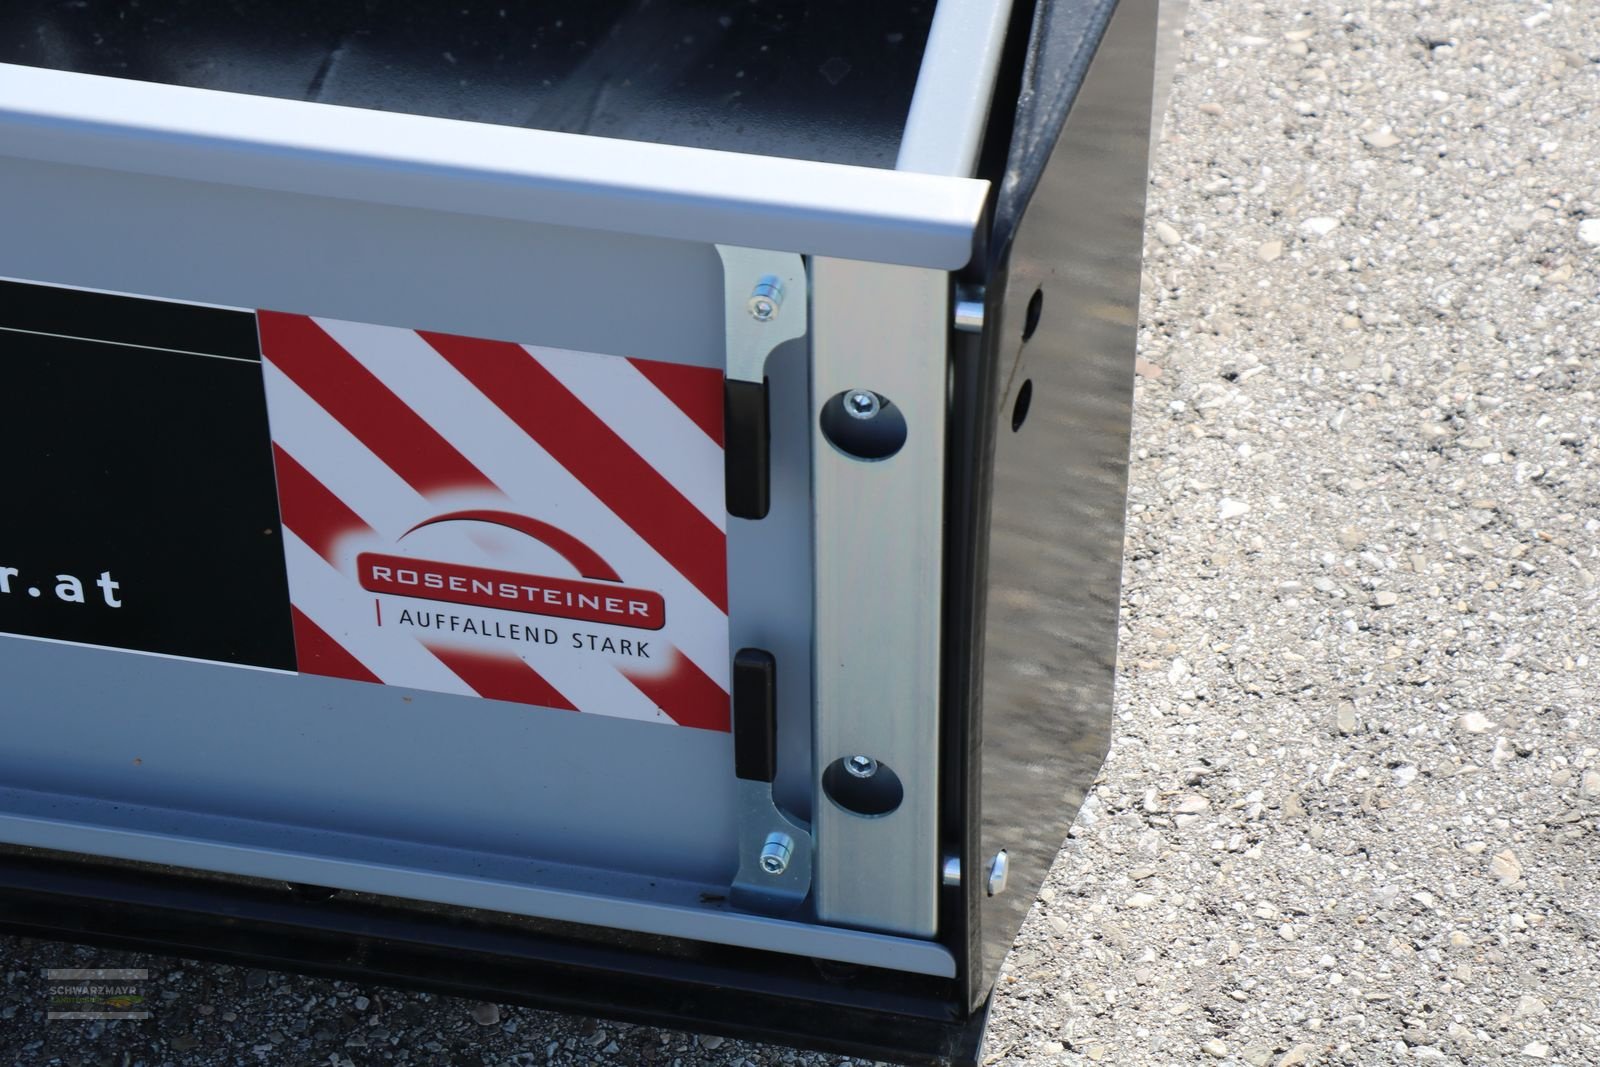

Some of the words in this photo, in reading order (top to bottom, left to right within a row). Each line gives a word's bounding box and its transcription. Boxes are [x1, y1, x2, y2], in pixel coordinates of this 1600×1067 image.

[372, 565, 649, 617] ROSENSTEINER
[399, 609, 559, 645] AUFFALLEND
[572, 632, 650, 658] STARK
